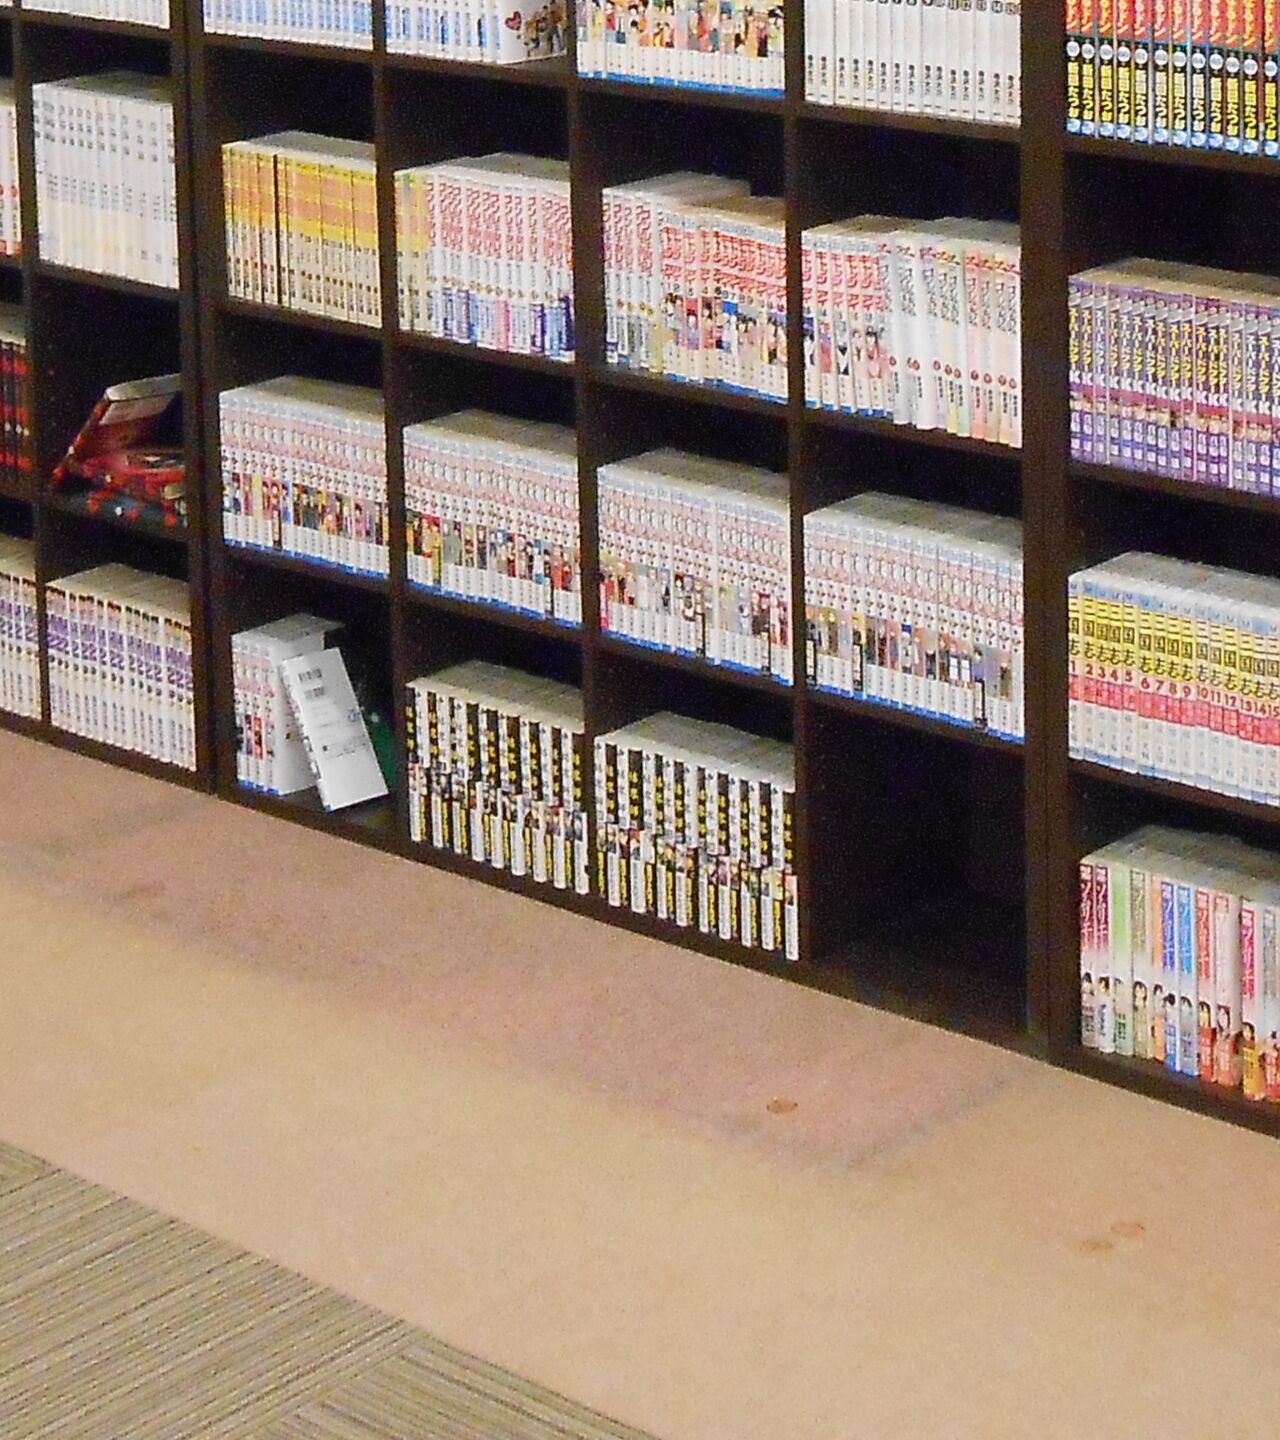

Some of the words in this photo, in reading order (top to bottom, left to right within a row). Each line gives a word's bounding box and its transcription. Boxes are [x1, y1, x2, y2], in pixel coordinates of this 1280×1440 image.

[1071, 661, 1076, 673] 1
[1086, 664, 1093, 675] 2
[1111, 669, 1119, 681] 4
[1125, 671, 1133, 682] 5
[1141, 678, 1149, 689] 6
[1156, 680, 1164, 691] 7
[1184, 686, 1191, 697] 9
[1211, 690, 1221, 702] 11
[1225, 694, 1236, 707] 12
[1254, 702, 1266, 715] 14
